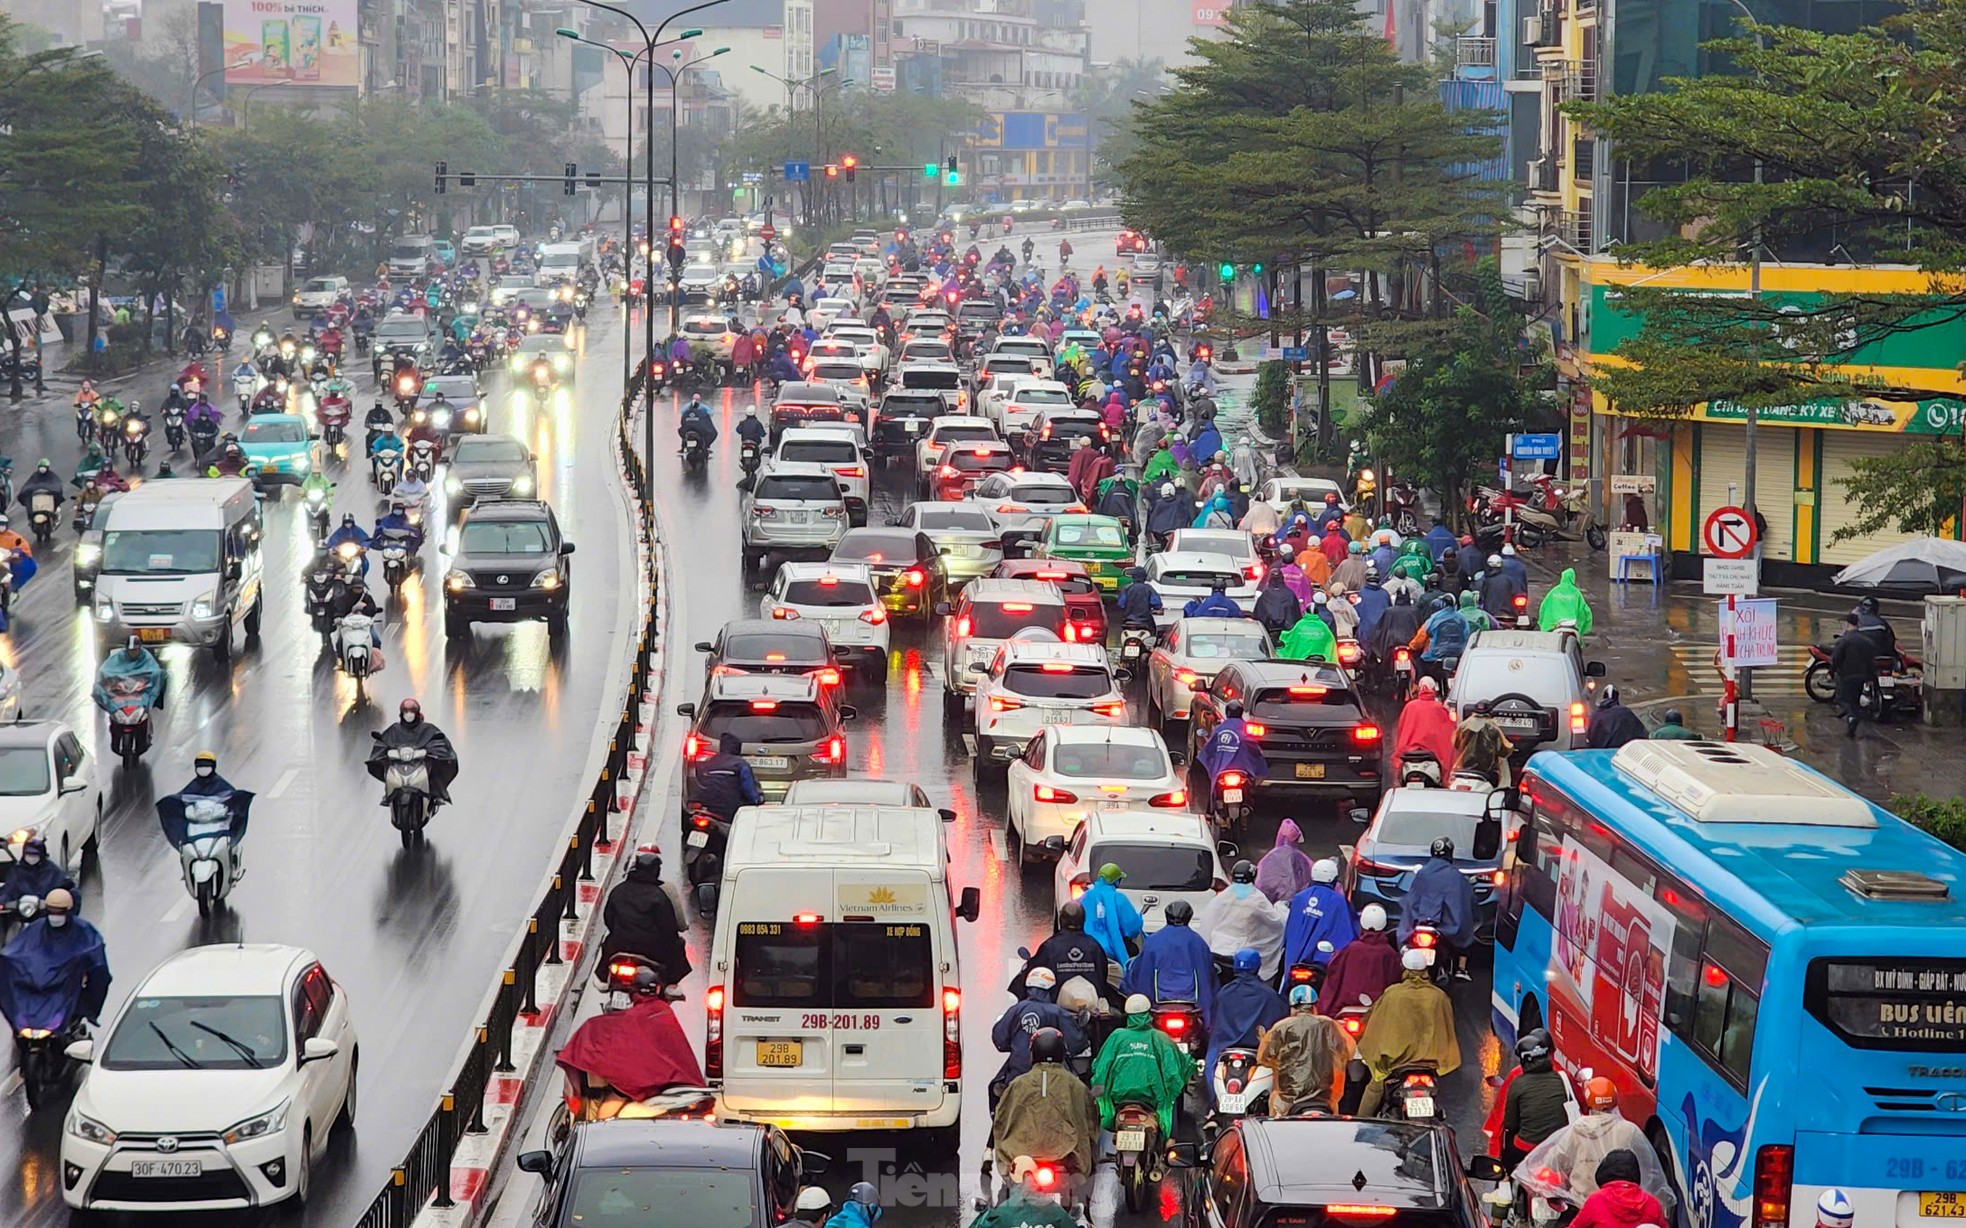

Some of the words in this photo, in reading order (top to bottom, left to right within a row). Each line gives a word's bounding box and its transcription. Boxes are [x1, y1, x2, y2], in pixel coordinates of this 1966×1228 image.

[1735, 606, 1756, 623] XÔI
[840, 904, 878, 912] Vietnam
[879, 904, 913, 912] Airlines
[1919, 969, 1935, 991] GIÁP
[1880, 1003, 1920, 1023] BUS
[801, 1014, 880, 1030] 29B-201.89
[1894, 1026, 1955, 1039] Hotline
[770, 1044, 789, 1053] 29B
[762, 1054, 797, 1065] 201.89
[1887, 1157, 1925, 1179] 29B
[1935, 1193, 1957, 1204] 29B
[1925, 1204, 1965, 1216] 621.43
